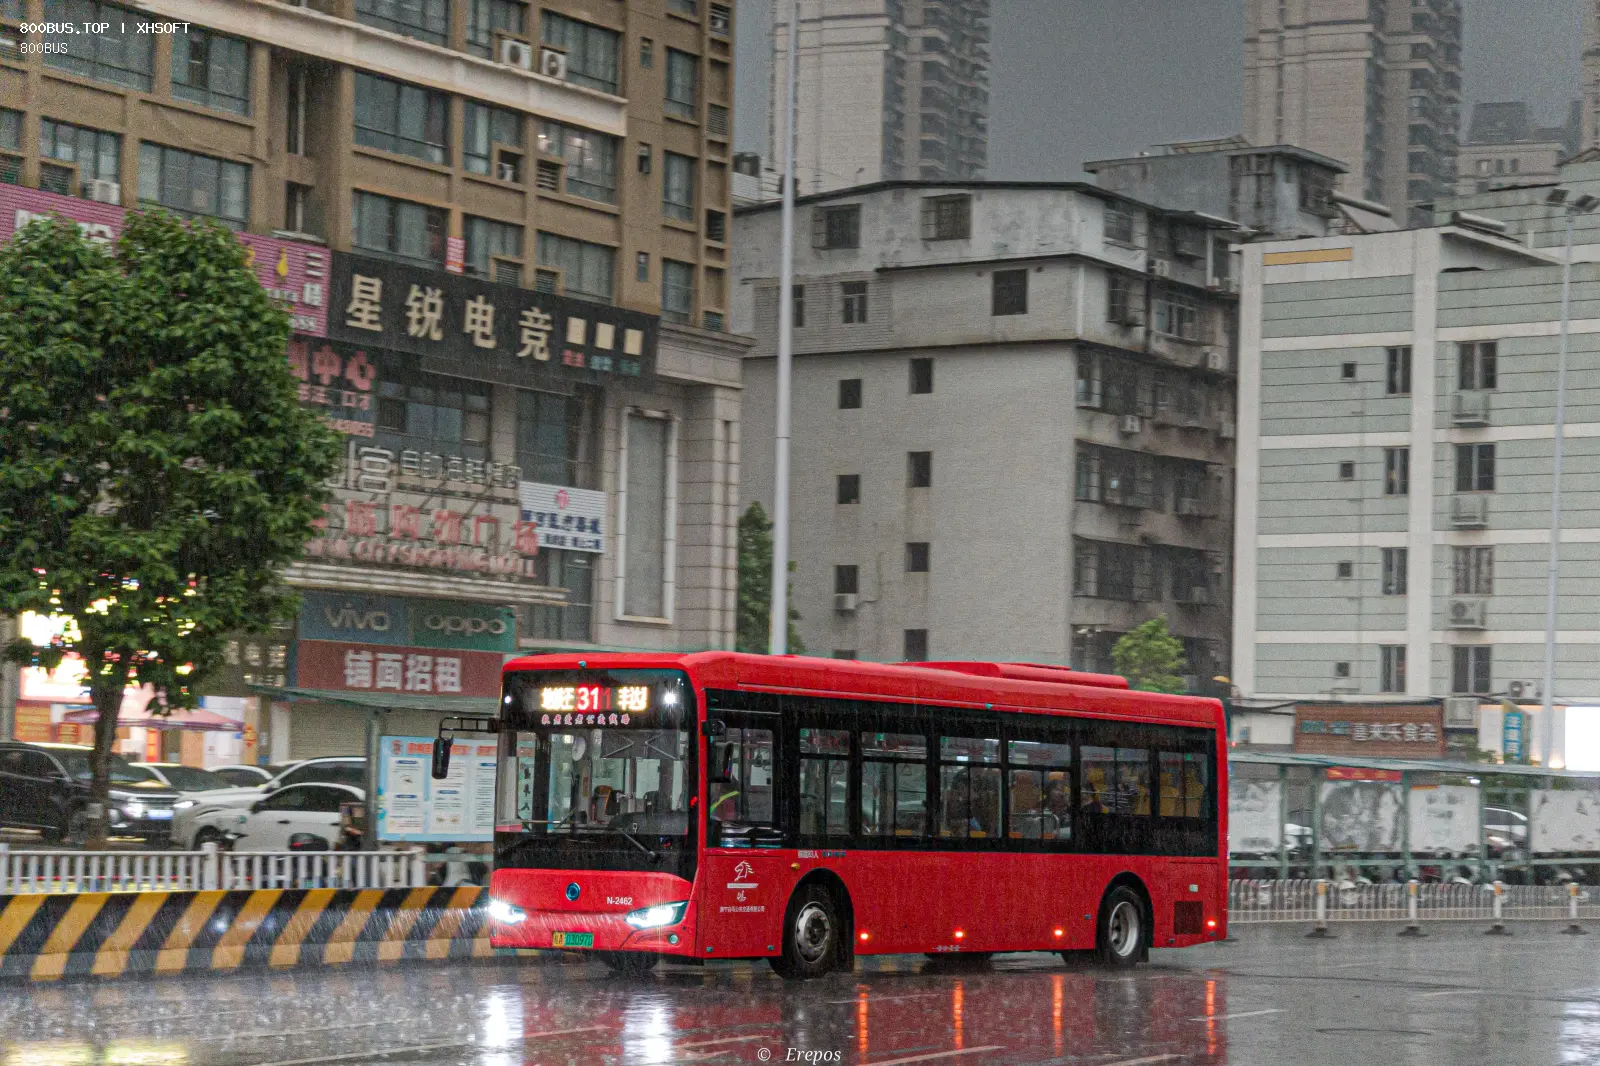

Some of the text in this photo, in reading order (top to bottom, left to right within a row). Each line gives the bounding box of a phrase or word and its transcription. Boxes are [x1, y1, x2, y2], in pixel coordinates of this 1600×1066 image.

[345, 273, 553, 361] 星锐电竞
[323, 603, 391, 632] vivo
[343, 649, 462, 692] 铺面招租
[577, 686, 600, 711] 31
[606, 896, 633, 906] N-2462
